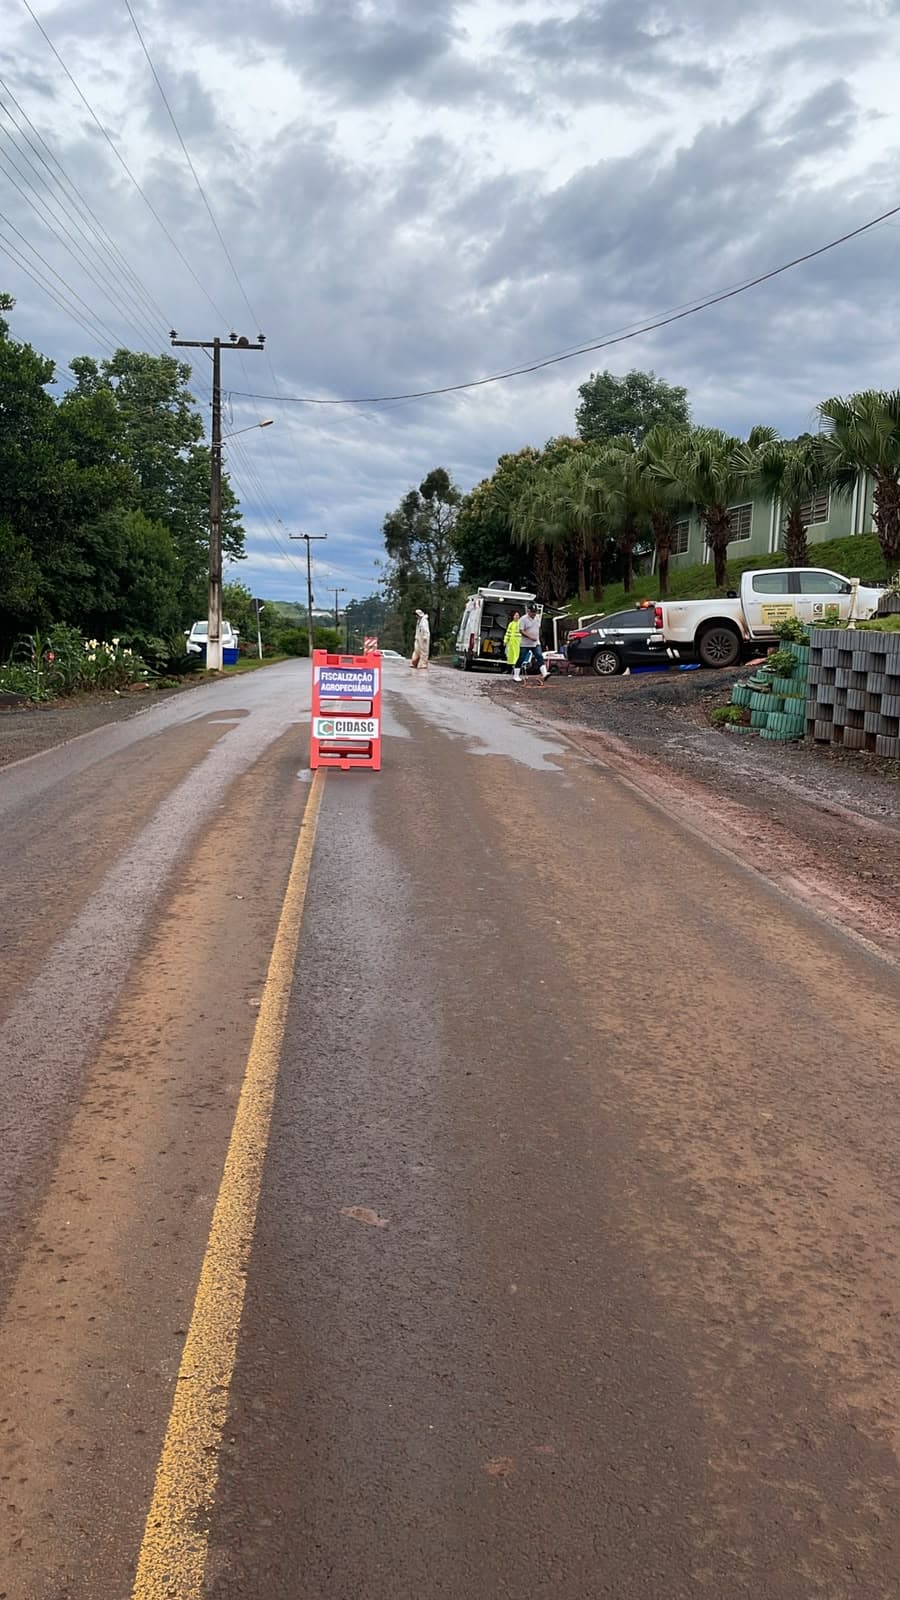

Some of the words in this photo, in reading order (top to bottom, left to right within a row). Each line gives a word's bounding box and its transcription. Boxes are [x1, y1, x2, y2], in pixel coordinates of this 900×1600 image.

[321, 672, 373, 682] FISCALIZAÇÃO
[321, 683, 373, 692] AGROPECUÁRIA
[335, 721, 374, 732] CIDASC
